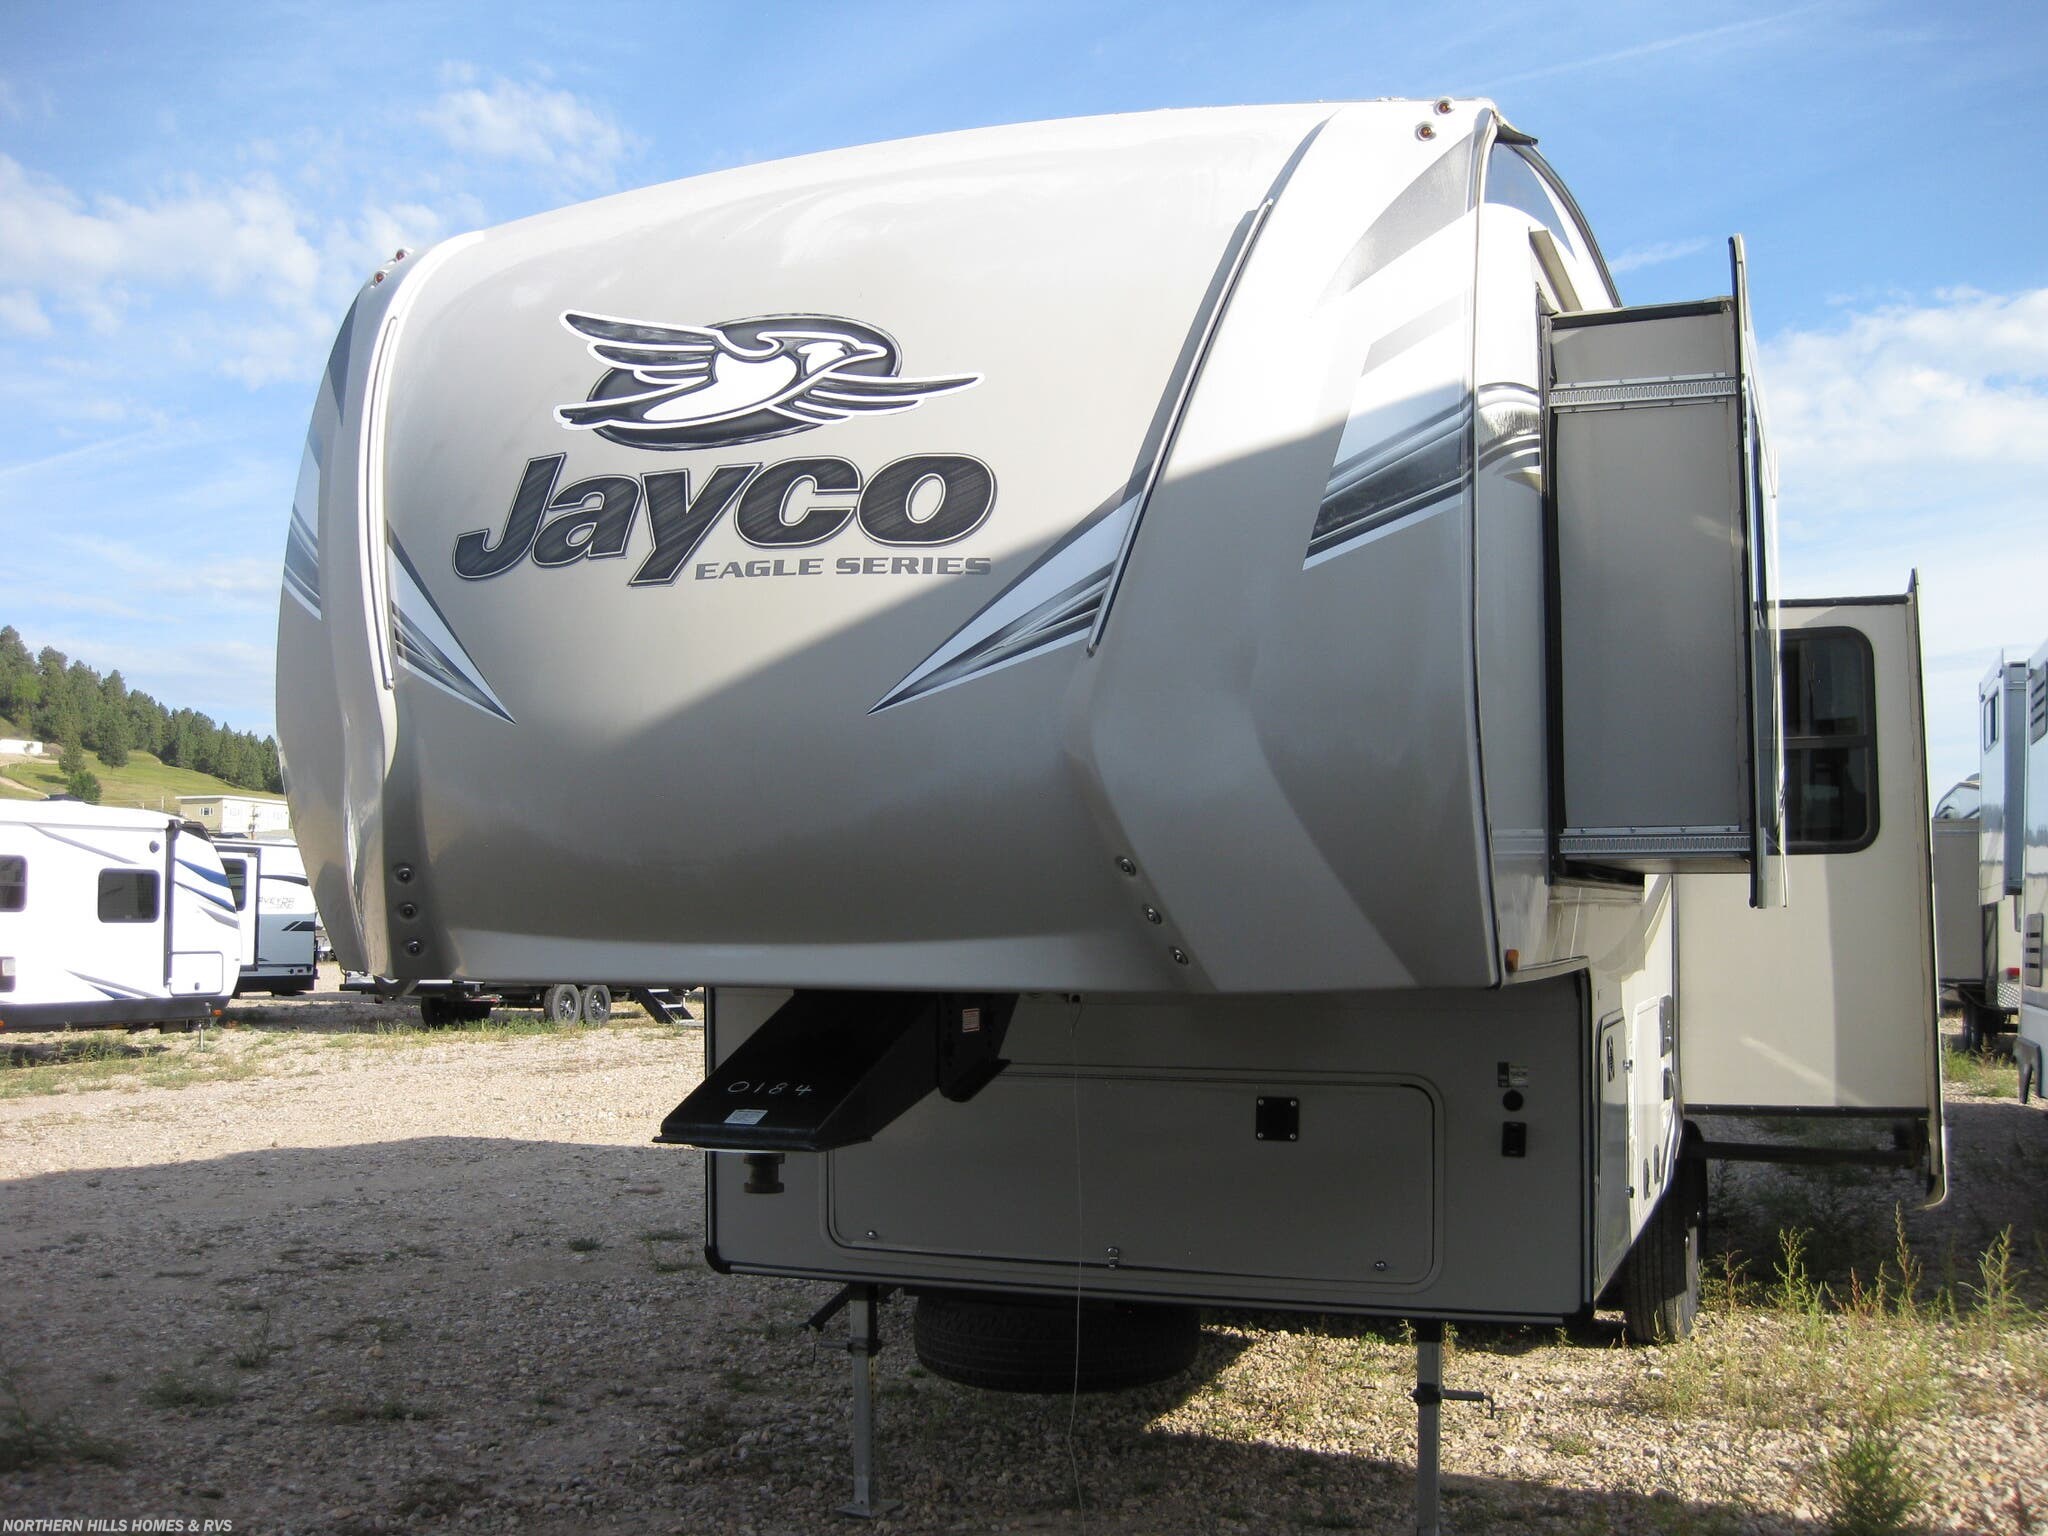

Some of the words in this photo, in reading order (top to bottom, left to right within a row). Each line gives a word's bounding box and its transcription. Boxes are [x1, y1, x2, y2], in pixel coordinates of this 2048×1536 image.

[453, 451, 998, 587] Jayco
[694, 557, 825, 580] EAGLE
[835, 556, 992, 576] SERIES
[727, 1080, 813, 1096] 0184
